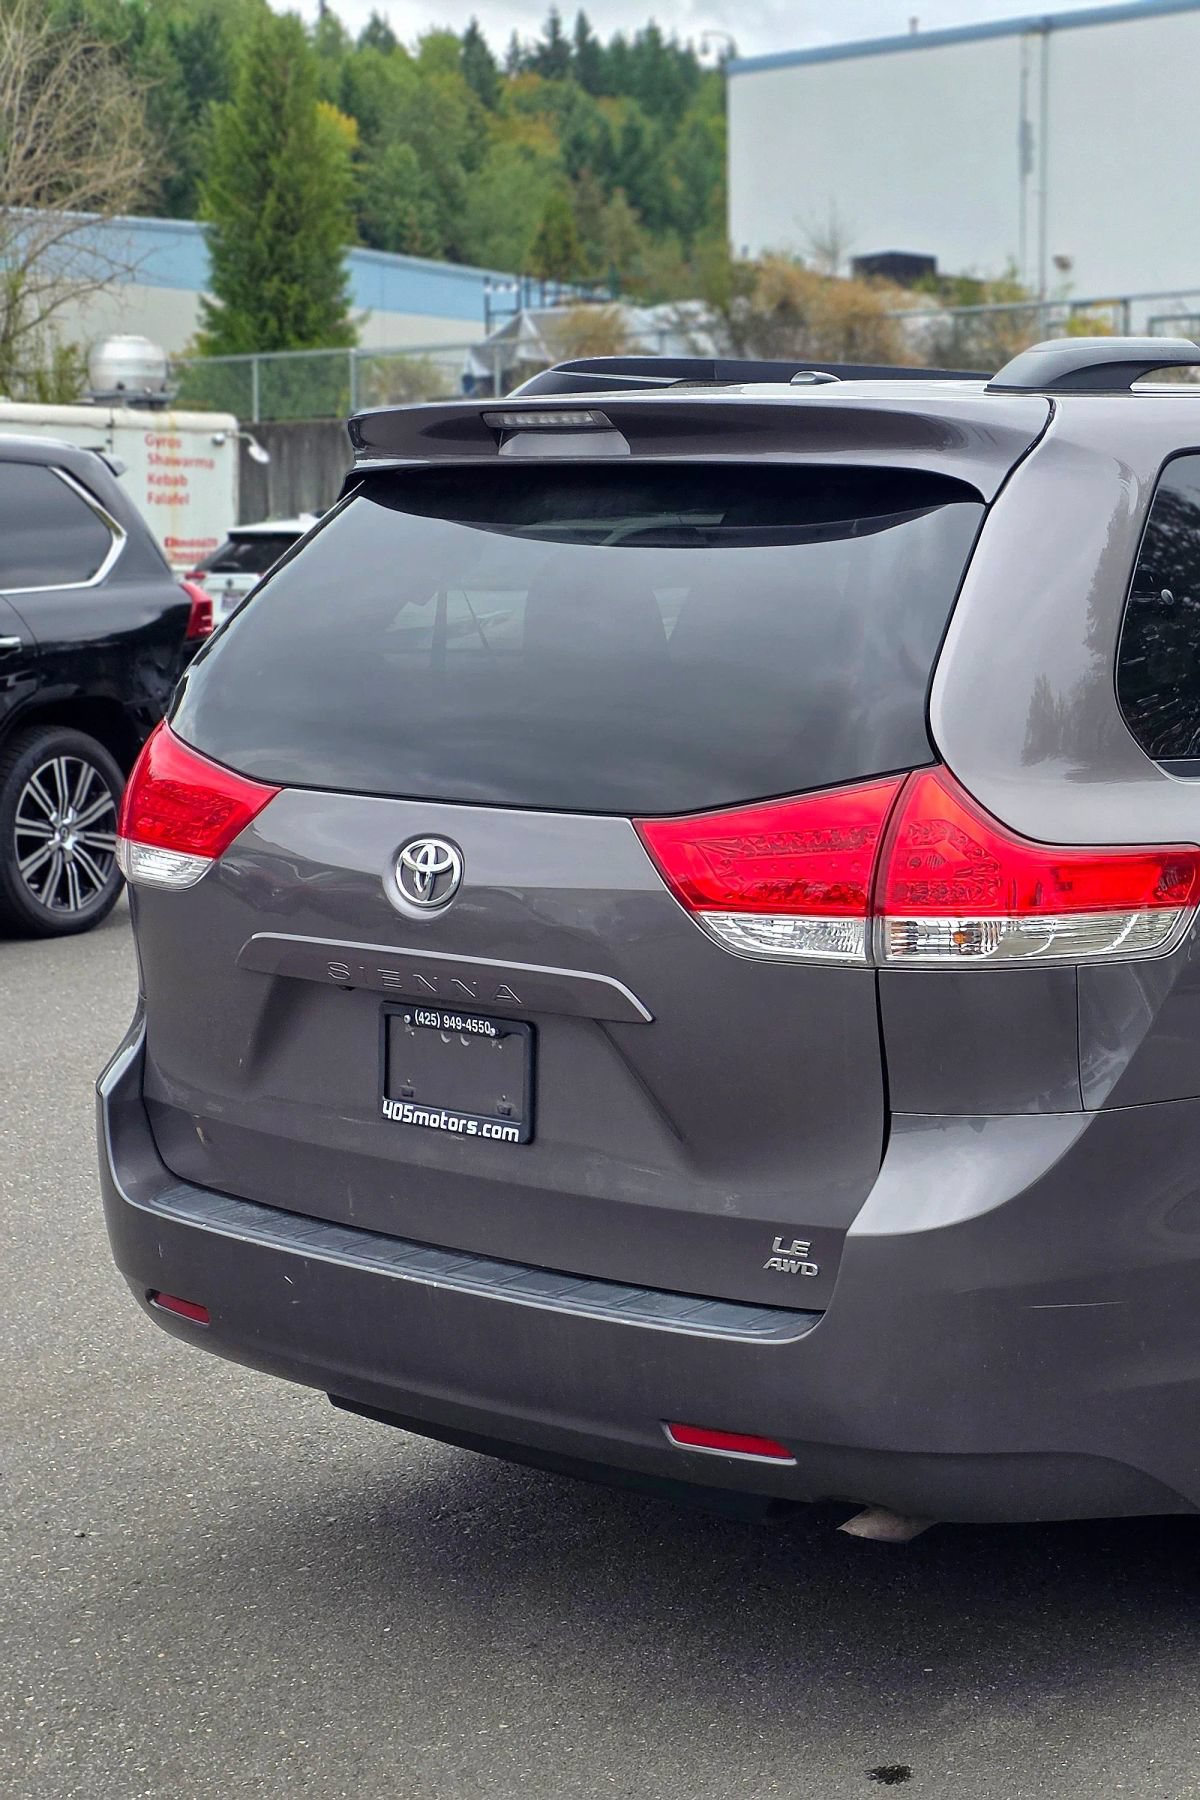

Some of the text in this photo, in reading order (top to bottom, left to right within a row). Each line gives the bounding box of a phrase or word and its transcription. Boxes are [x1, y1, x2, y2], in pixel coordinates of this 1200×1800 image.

[327, 961, 523, 1004] SIENNA
[414, 1009, 491, 1035] (425) 949-4550
[382, 1100, 519, 1143] 405motors.com
[772, 1236, 811, 1258] LE
[763, 1257, 818, 1277] AWD
